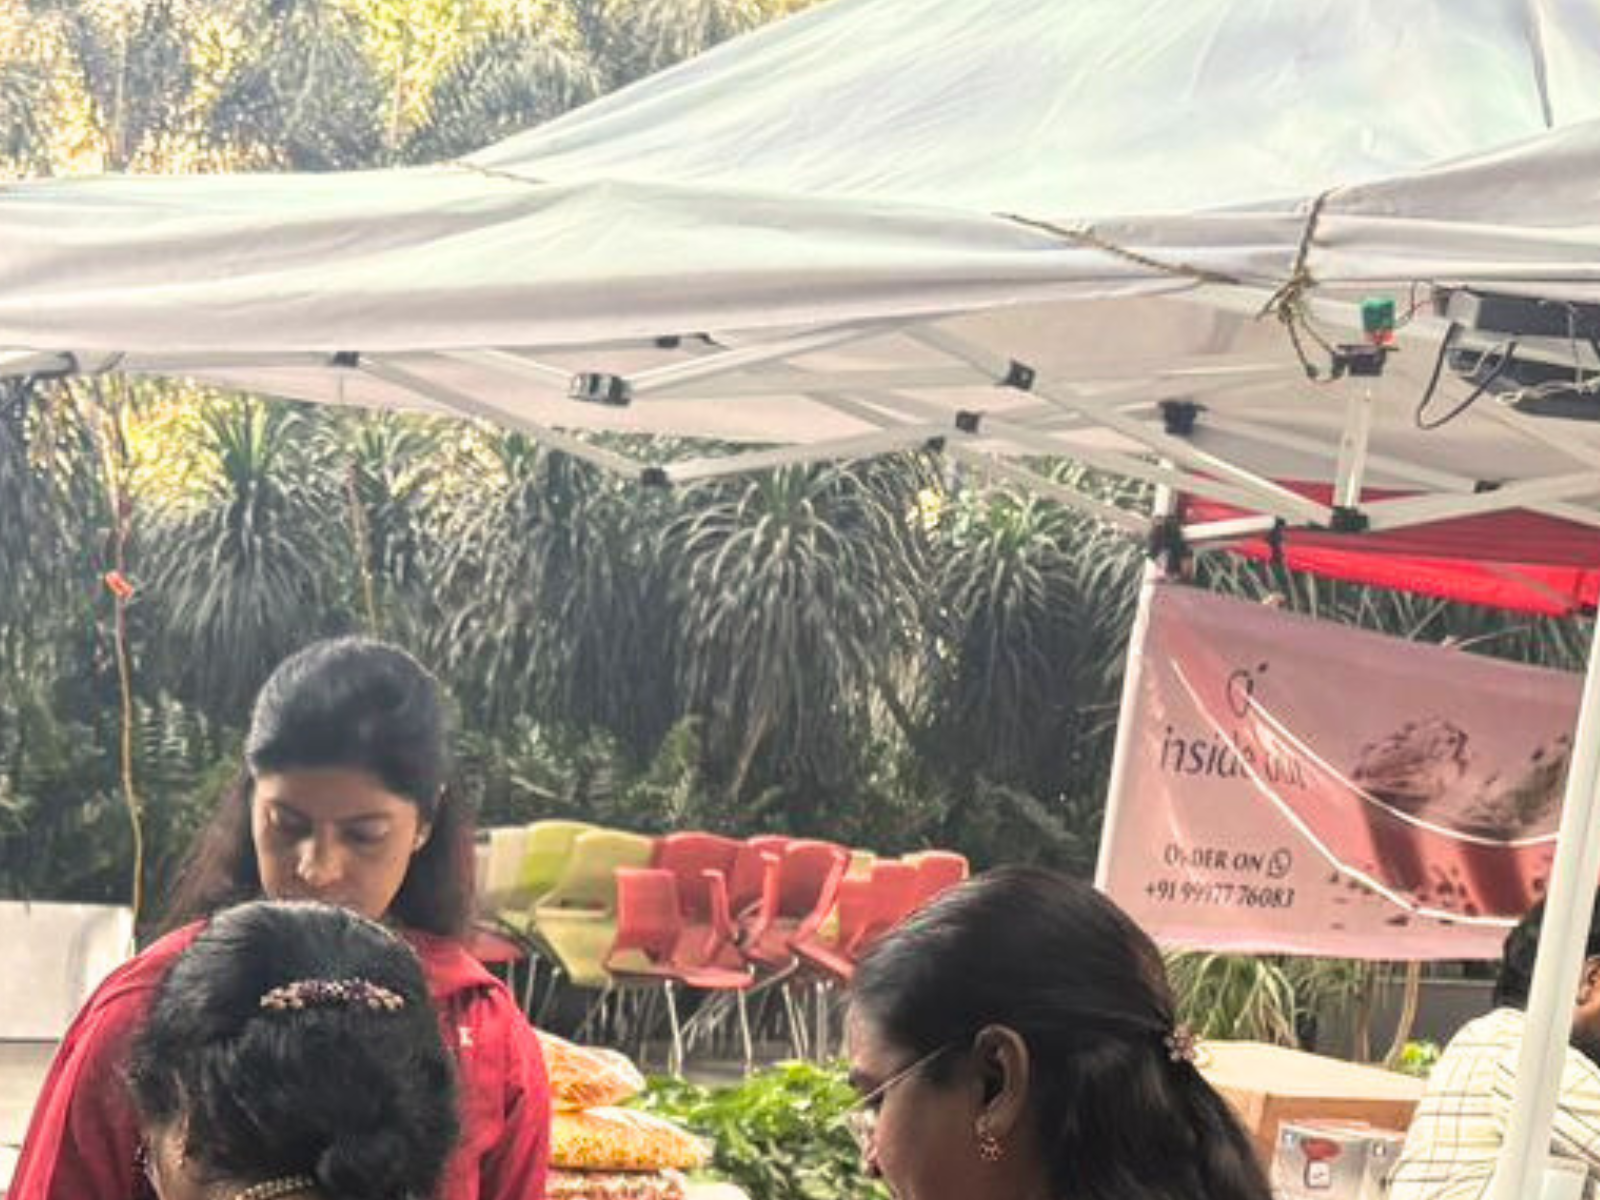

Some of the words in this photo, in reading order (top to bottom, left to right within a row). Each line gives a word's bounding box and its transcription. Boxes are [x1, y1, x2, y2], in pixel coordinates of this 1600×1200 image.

[1161, 725, 1256, 779] inside
[1232, 852, 1265, 874] ON
[1145, 879, 1177, 901] +91
